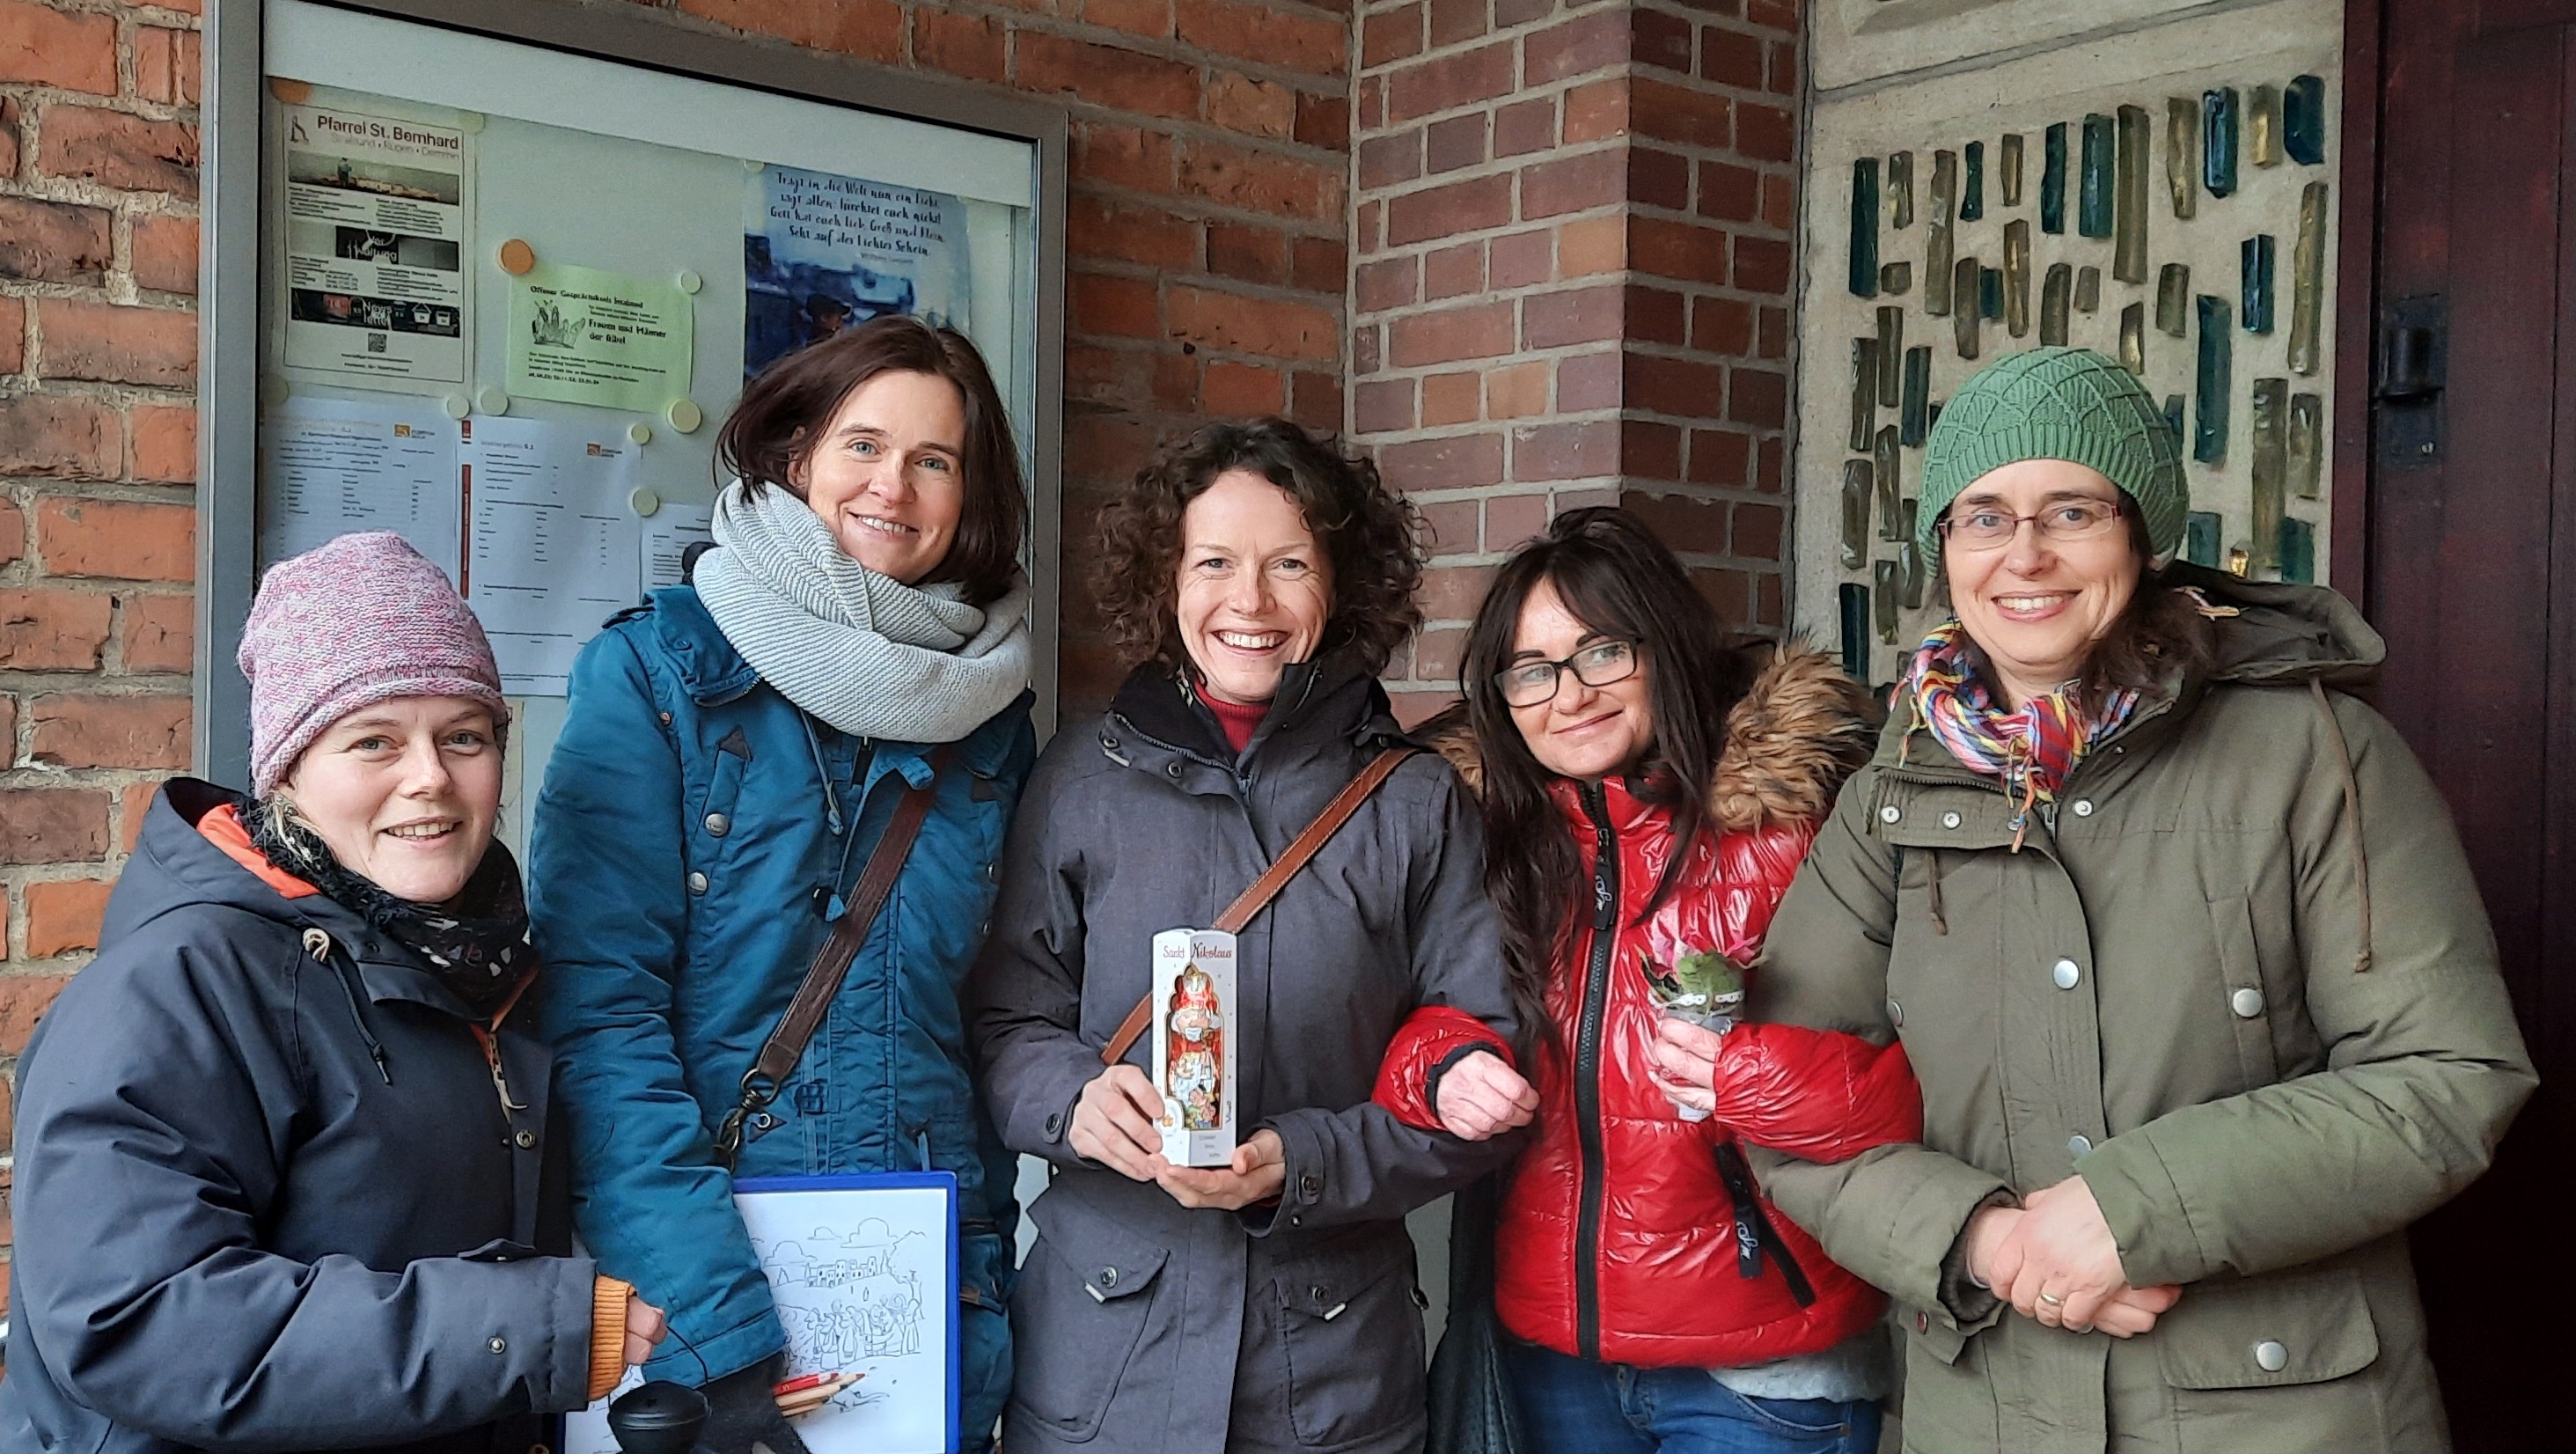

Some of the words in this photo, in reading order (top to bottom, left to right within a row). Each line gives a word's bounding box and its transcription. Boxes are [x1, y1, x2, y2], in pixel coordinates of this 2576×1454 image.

[318, 114, 366, 135] Pfarrei
[370, 123, 390, 138] St.
[393, 127, 459, 149] Bernhard
[775, 172, 804, 194] Tragt
[809, 179, 820, 190] in
[824, 179, 841, 192] die
[845, 180, 867, 195] Welt
[870, 189, 892, 202] nun
[896, 194, 912, 204] ein
[781, 193, 802, 210] sagt
[884, 206, 909, 220] euch
[770, 205, 791, 219] Gott
[795, 208, 811, 222] hat
[816, 213, 841, 227] euch
[895, 224, 917, 237] und
[789, 224, 811, 239] Seht
[813, 228, 834, 247] auf
[836, 231, 854, 245] des
[589, 332, 604, 341] der
[618, 325, 633, 334] und
[1163, 944, 1185, 959] Sankt
[1191, 941, 1232, 959] Nikolaus
